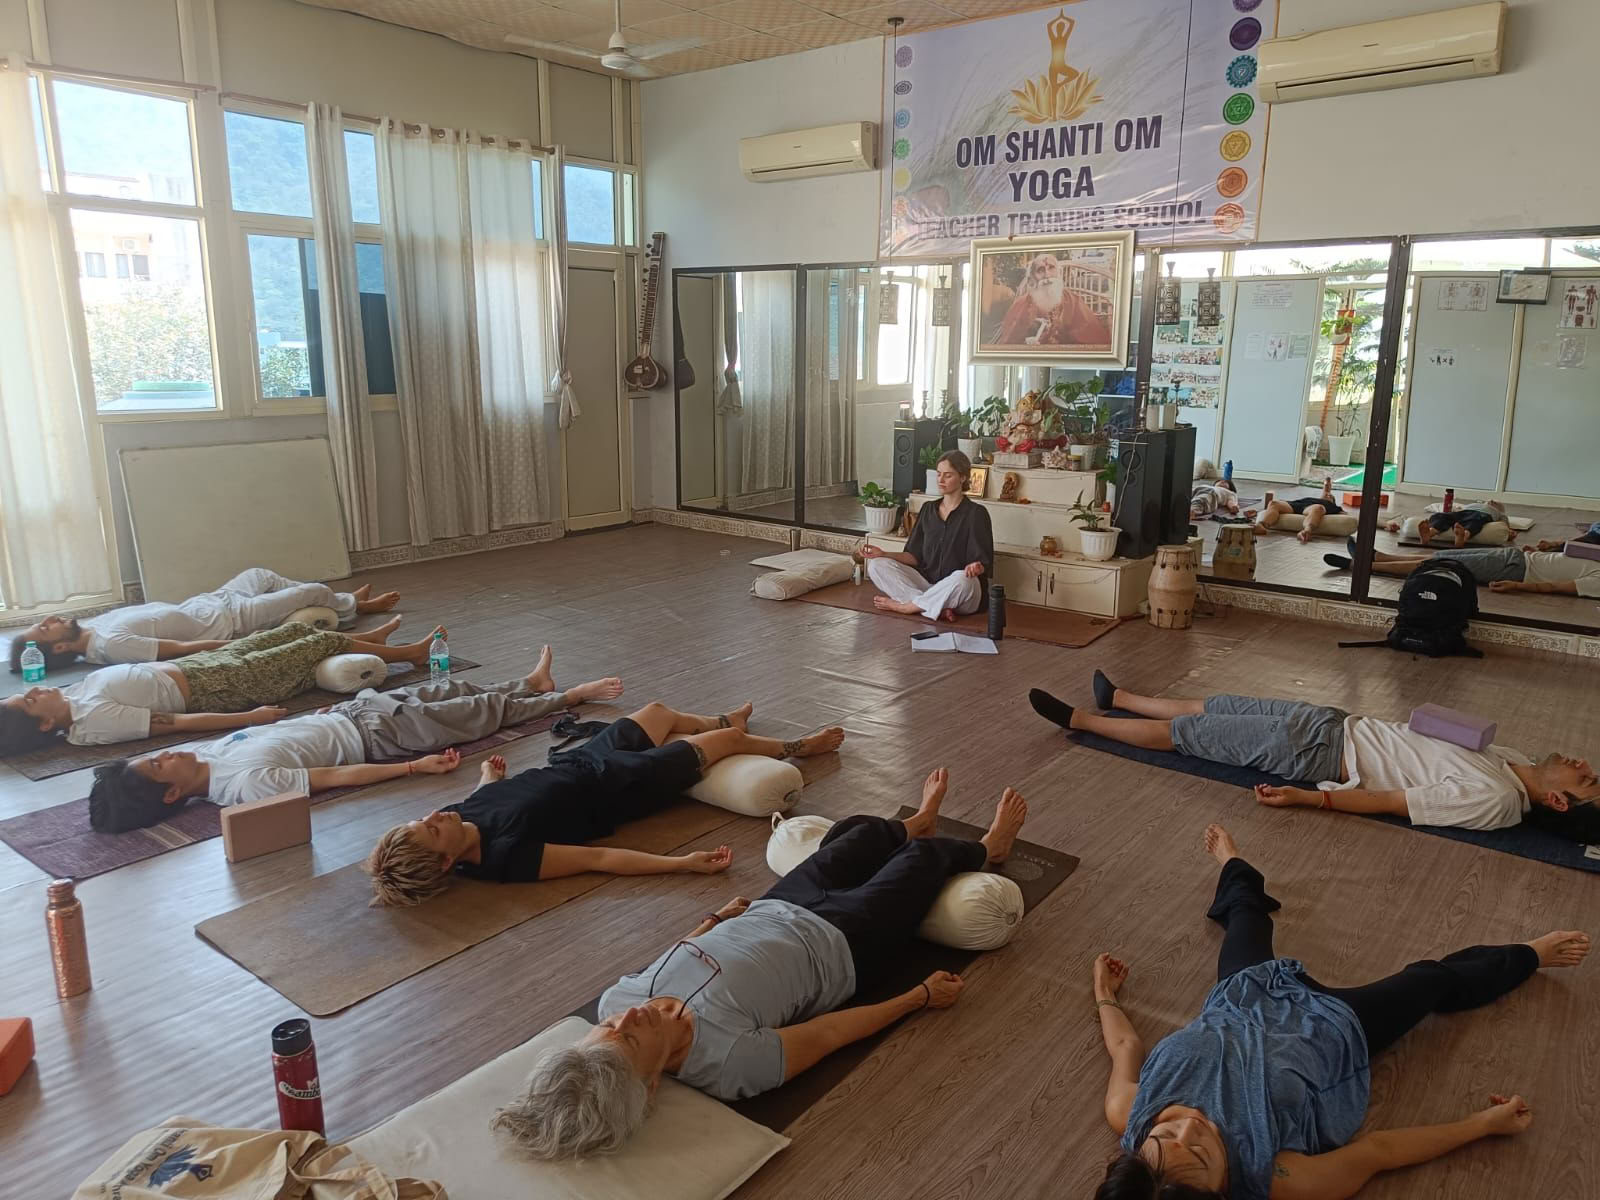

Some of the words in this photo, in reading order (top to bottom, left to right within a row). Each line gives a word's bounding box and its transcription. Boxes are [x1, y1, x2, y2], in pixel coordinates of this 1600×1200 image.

[956, 135, 996, 168] OM
[1005, 122, 1103, 163] SHANTI
[1114, 115, 1162, 152] OM
[1009, 166, 1095, 202] YOGA
